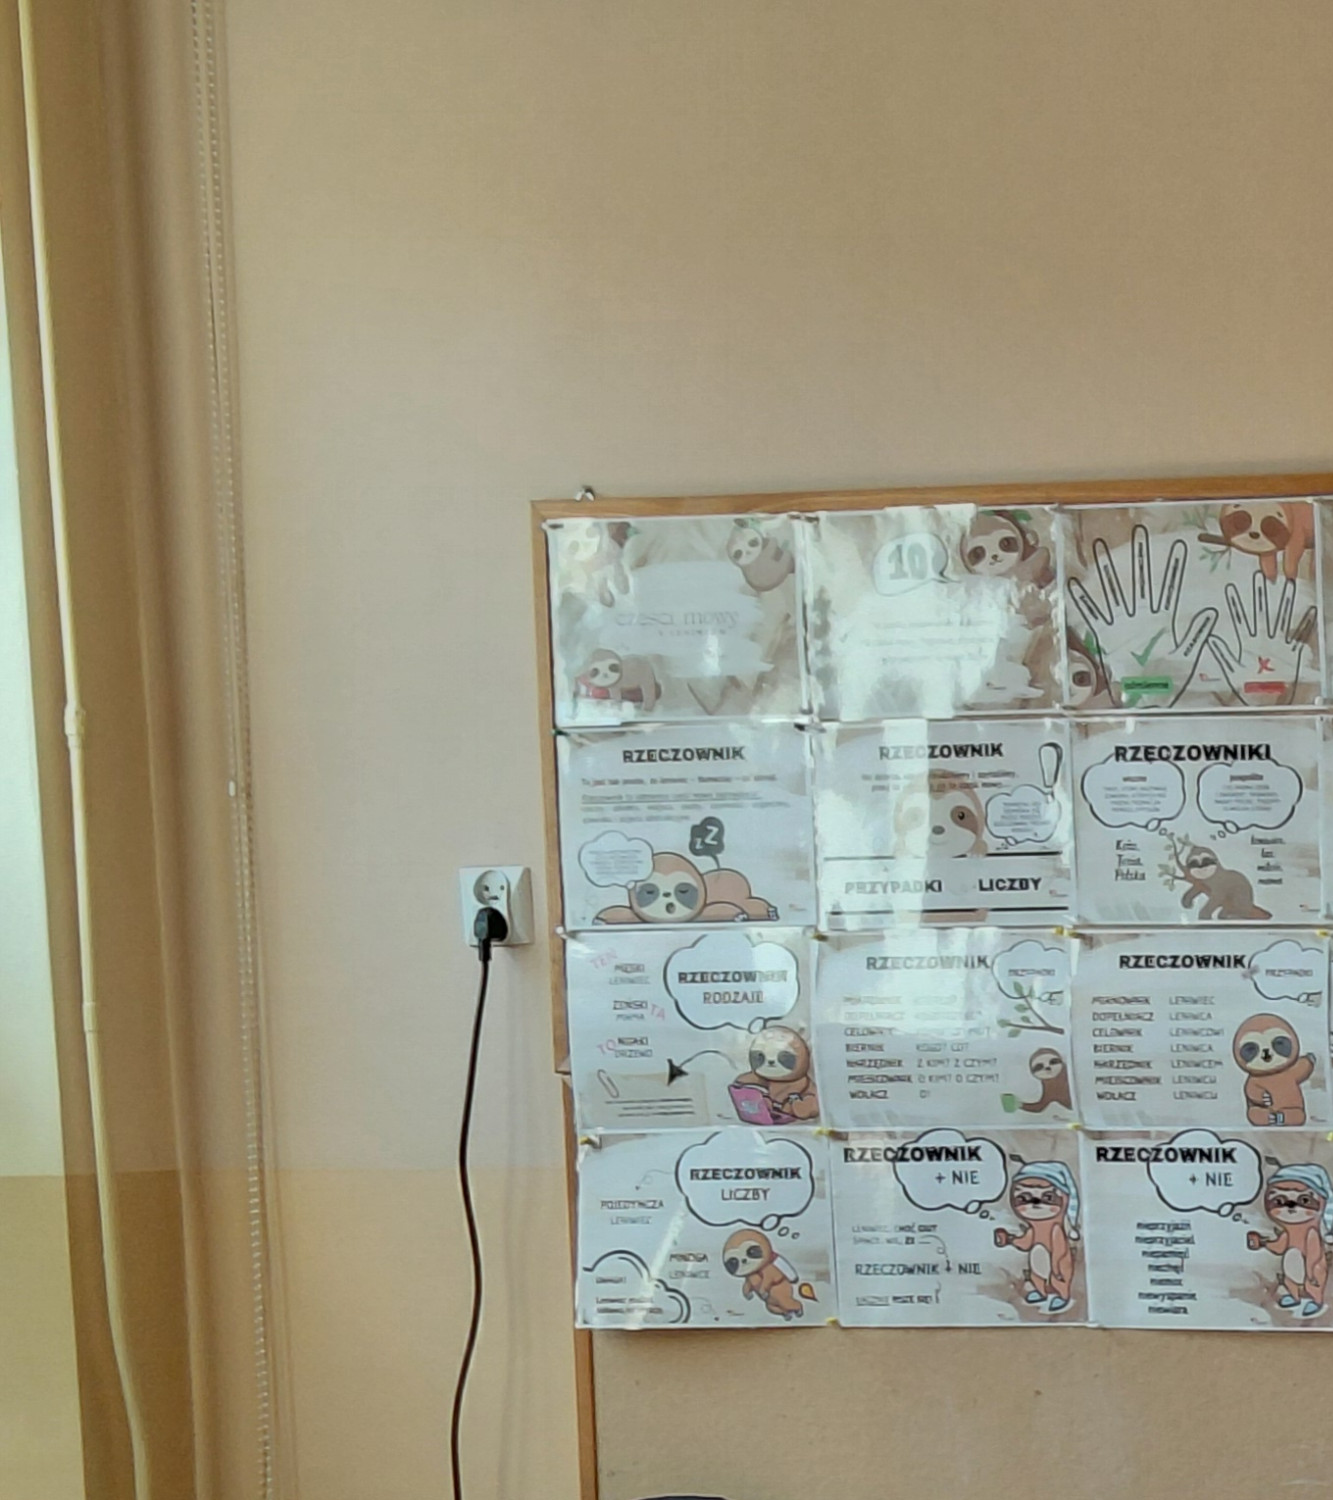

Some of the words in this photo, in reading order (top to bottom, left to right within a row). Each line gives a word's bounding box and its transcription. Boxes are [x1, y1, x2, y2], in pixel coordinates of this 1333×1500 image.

[622, 746, 747, 763] RZECZOWNIK
[879, 742, 1004, 760] RZECZOWNIK
[1114, 744, 1272, 762] RZECZOWNIKI
[845, 879, 943, 894] PRZYPADKI
[978, 877, 1042, 892] LICZBY
[866, 955, 991, 970] RZECZOWNIK
[1119, 954, 1247, 969] RZECZOWNIK
[843, 1145, 983, 1163] RZECZOWNIK
[1096, 1147, 1238, 1163] RZECZOWNIK
[690, 1167, 802, 1181] RZECZOWNIK
[952, 1170, 980, 1185] NIE
[1205, 1172, 1234, 1187] NIE
[721, 1188, 770, 1201] LICZBY
[855, 1263, 940, 1276] RZECZOWNIK
[958, 1263, 983, 1275] NIE
